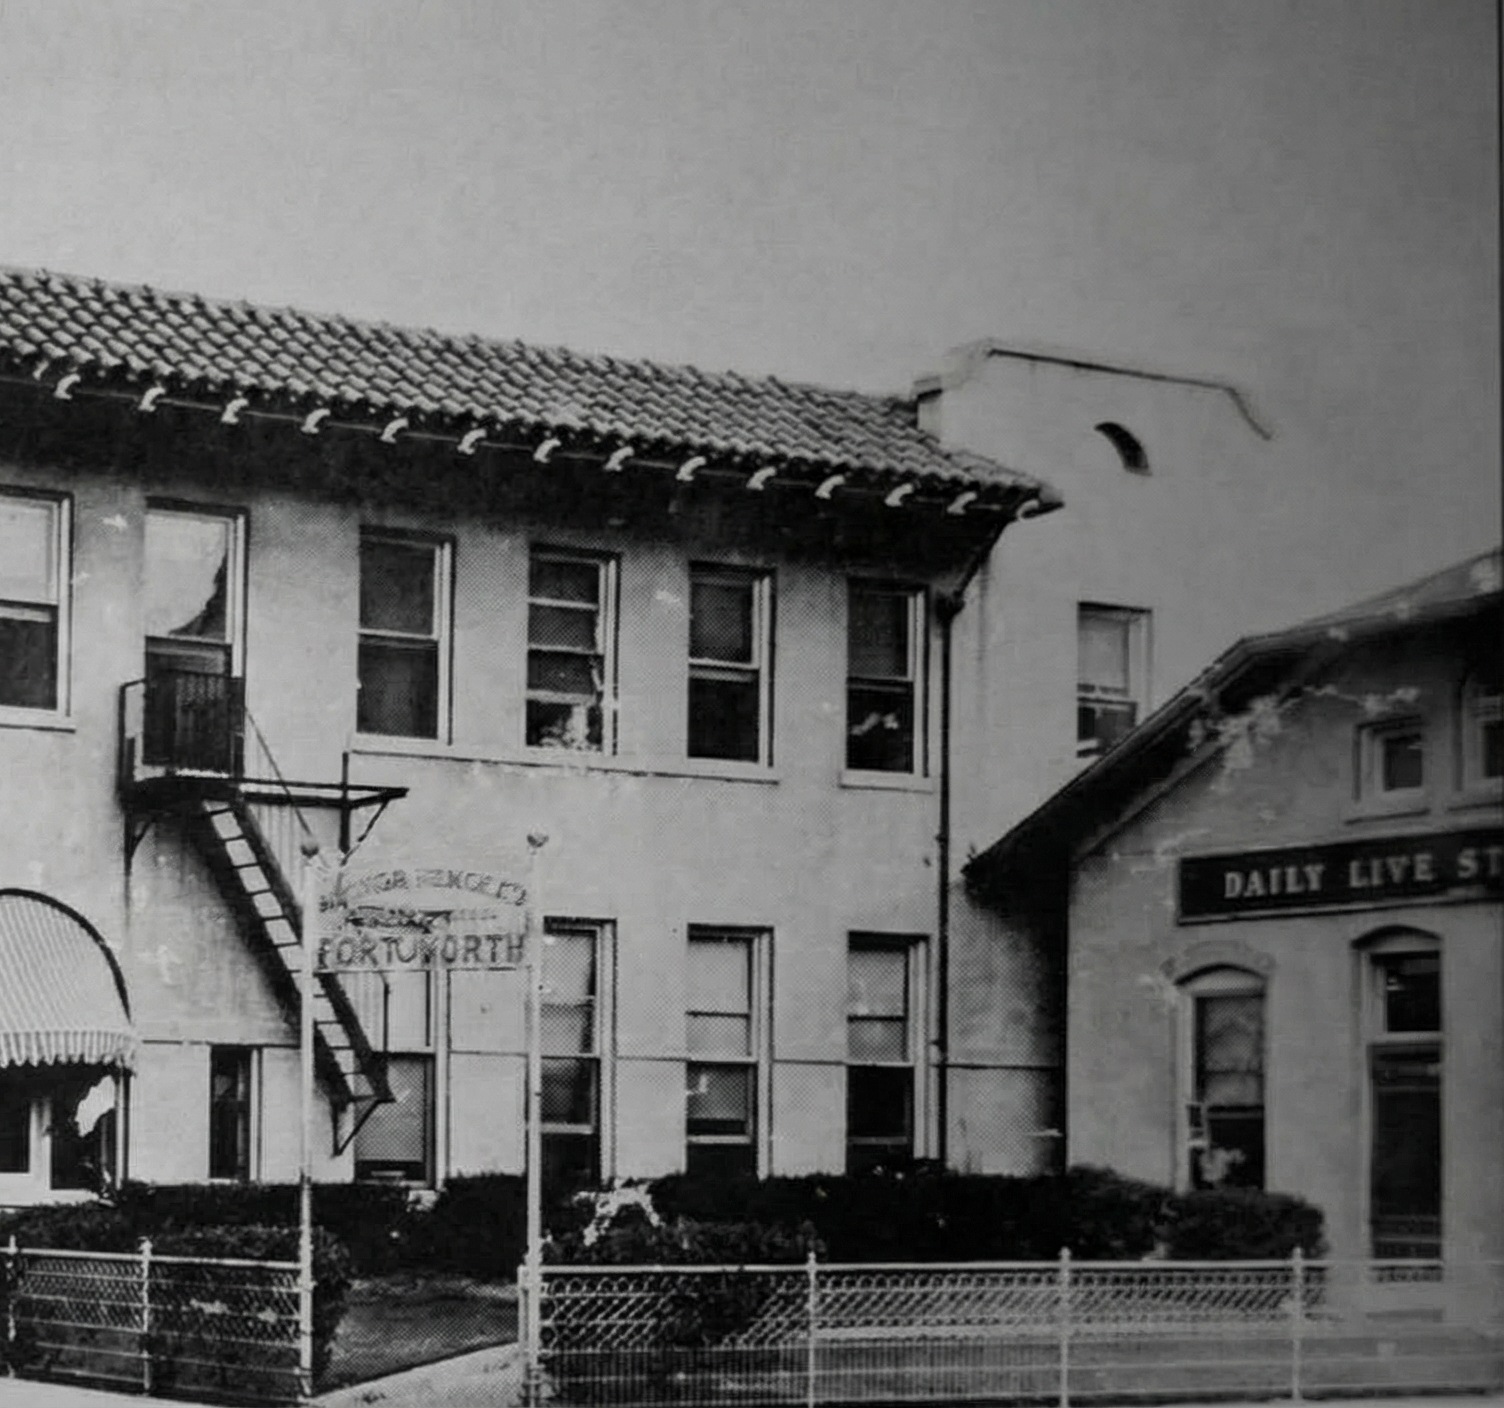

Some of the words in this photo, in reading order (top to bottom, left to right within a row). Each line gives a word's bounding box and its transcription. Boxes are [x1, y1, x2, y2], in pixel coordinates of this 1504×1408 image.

[1224, 864, 1325, 899] DAILY
[1349, 854, 1434, 889] LIVE
[1457, 844, 1503, 879] ST
[318, 934, 397, 970] FORT
[396, 934, 525, 965] WORTH
